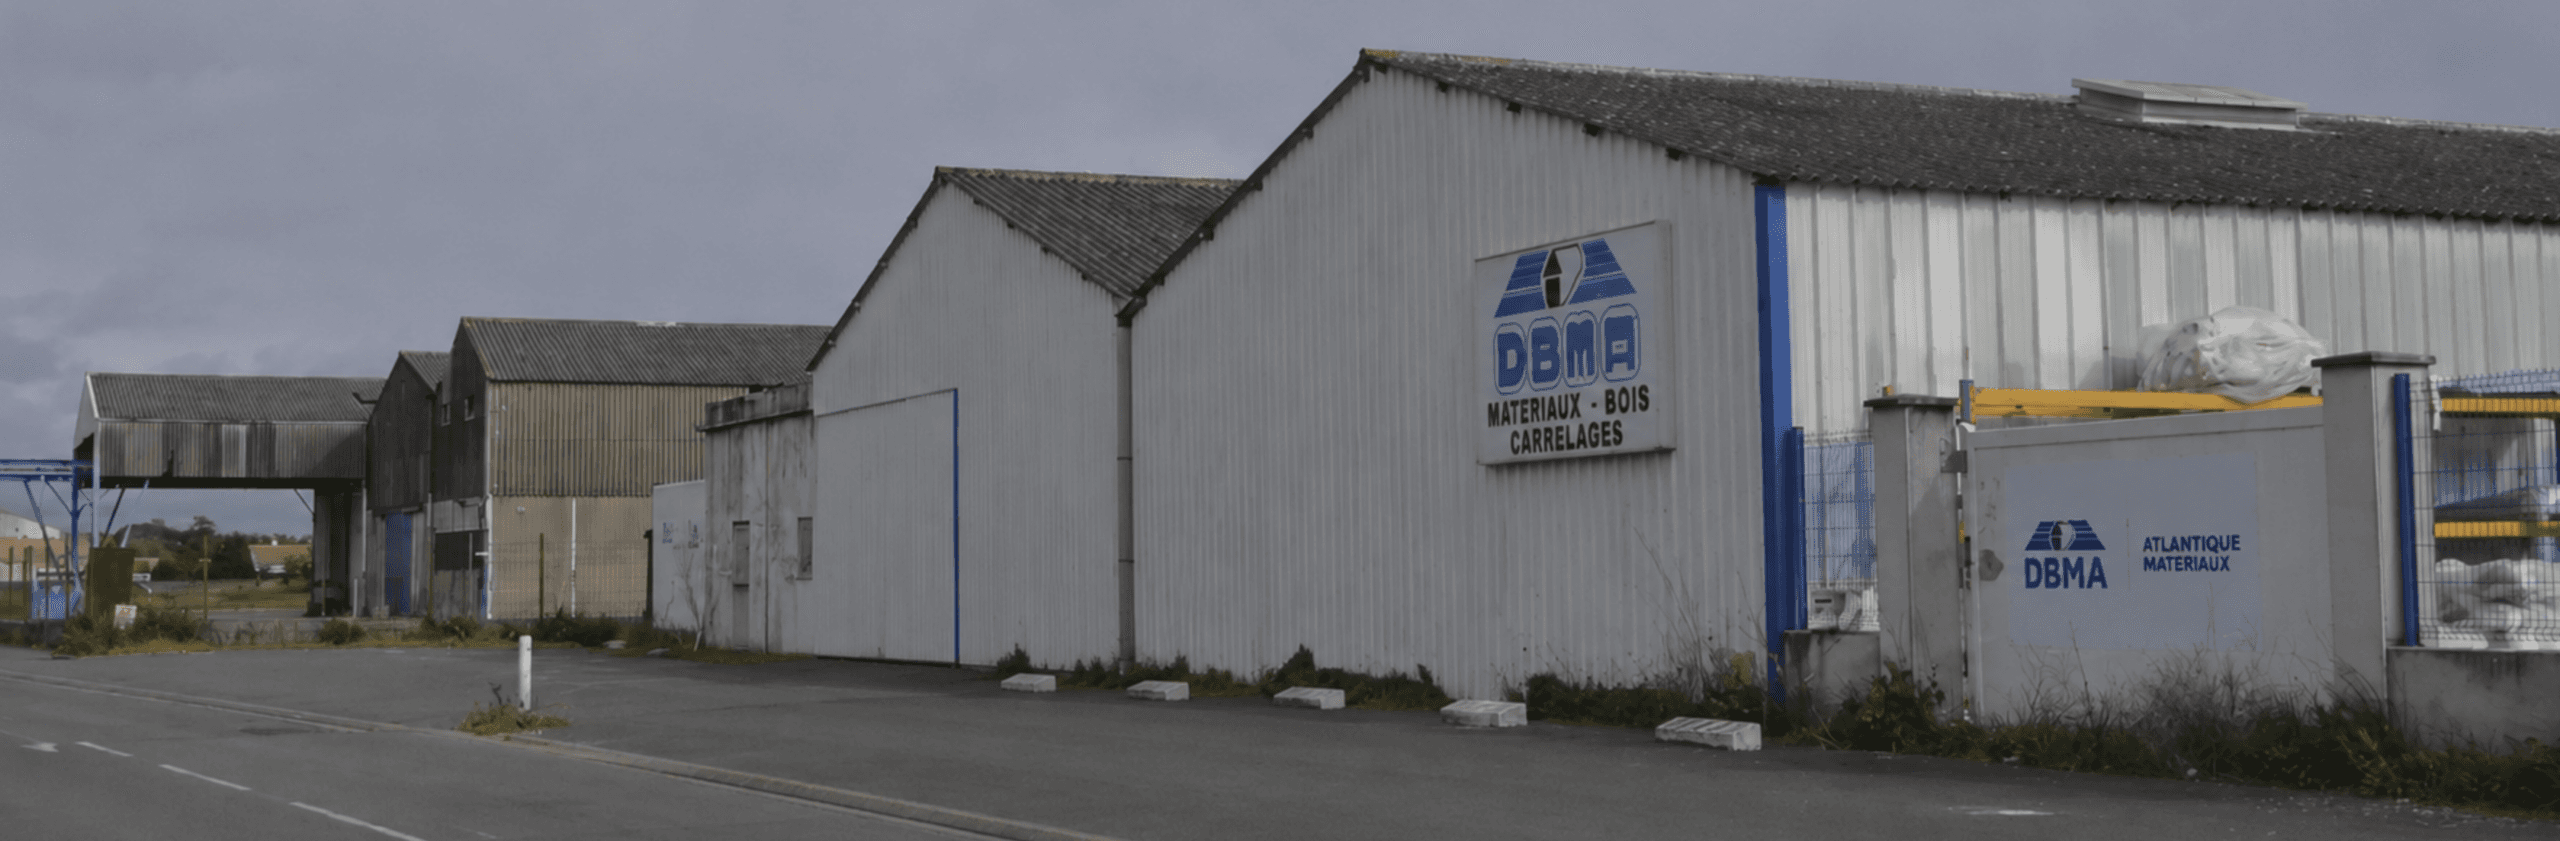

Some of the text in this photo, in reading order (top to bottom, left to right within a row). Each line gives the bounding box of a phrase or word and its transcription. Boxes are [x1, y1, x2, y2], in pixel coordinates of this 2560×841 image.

[1495, 309, 1639, 391] DBMA
[1487, 393, 1580, 427] MATERIAUX
[1604, 385, 1649, 415] BOIS
[1510, 420, 1622, 454] CARRELAGES
[2143, 535, 2241, 553] ATLANTIQUE
[2024, 556, 2108, 589] DBMA
[2143, 556, 2230, 572] MATERIAUX
